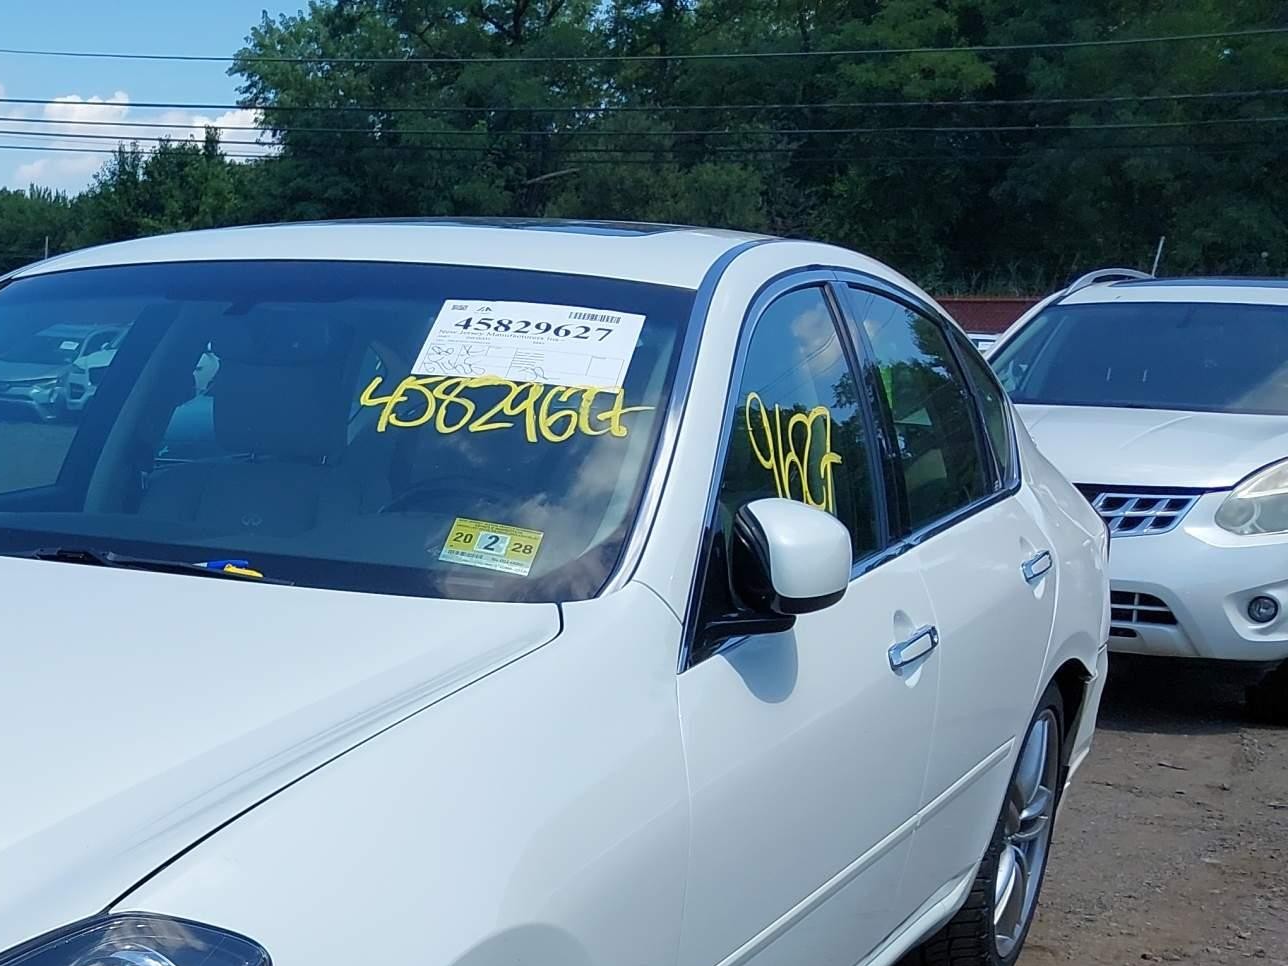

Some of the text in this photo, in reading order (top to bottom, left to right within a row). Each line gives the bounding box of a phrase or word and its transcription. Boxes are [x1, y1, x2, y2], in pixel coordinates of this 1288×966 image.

[454, 316, 613, 342] 45829627
[453, 531, 534, 554] 20 2 28
